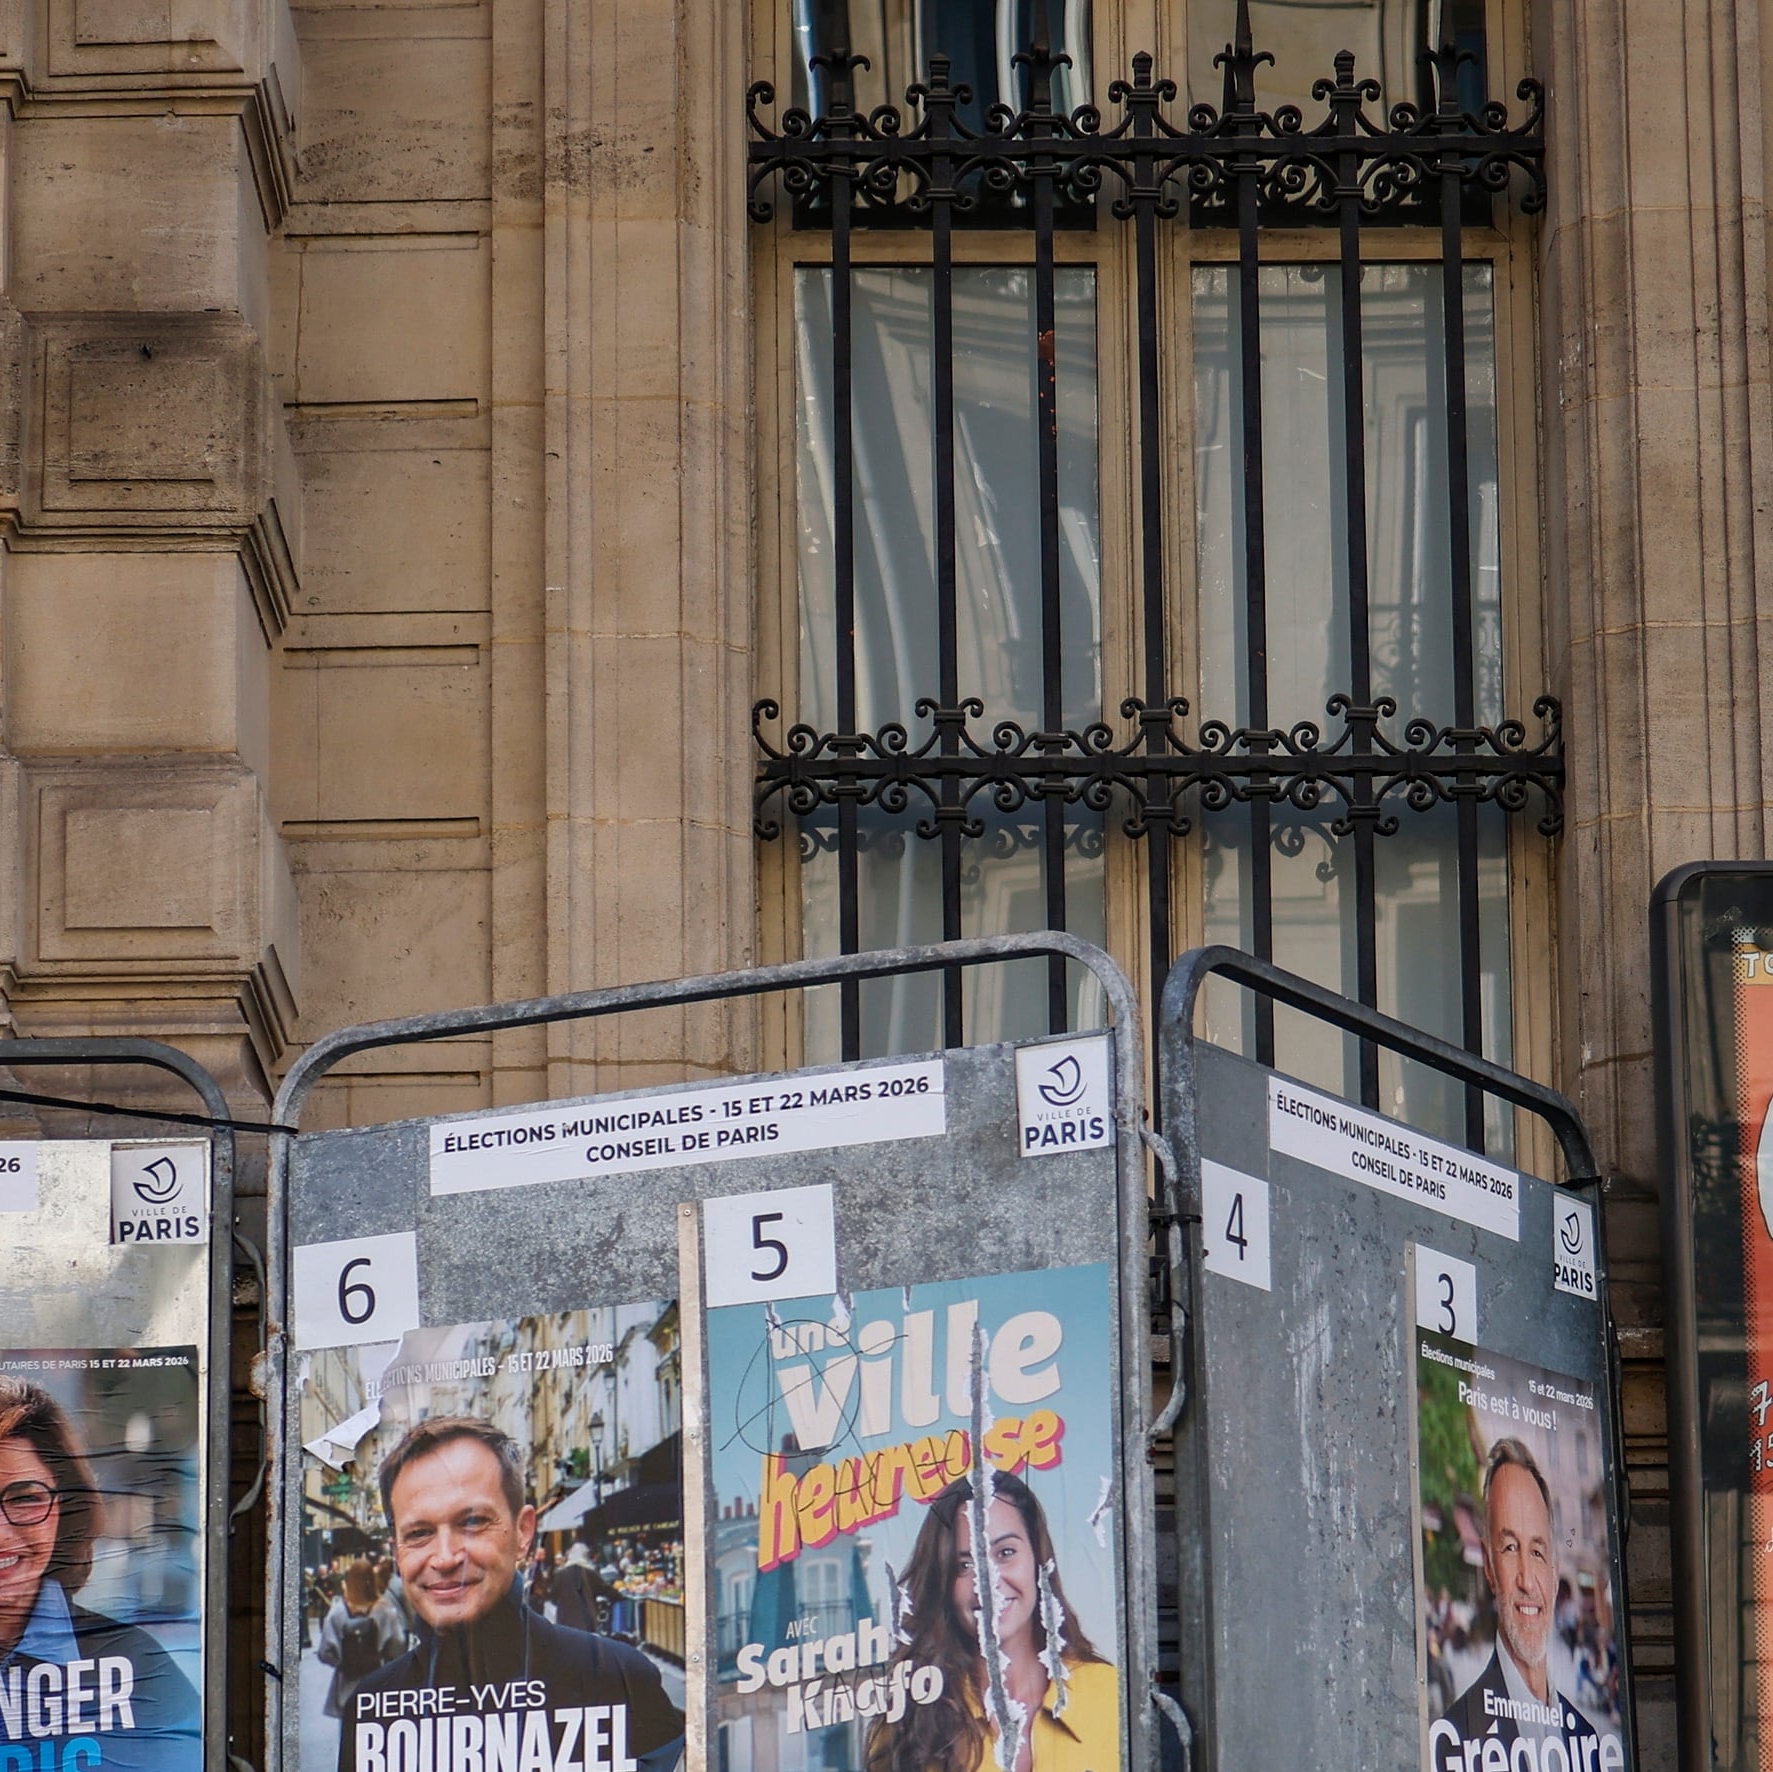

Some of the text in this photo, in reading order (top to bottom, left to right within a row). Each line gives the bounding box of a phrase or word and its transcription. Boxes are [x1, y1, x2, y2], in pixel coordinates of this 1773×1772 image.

[445, 1077, 928, 1152] ÉLECTIONS MUNICIPALES 15 ET 22 MARS 2026
[1026, 1117, 1104, 1148] PARIS
[1037, 1107, 1091, 1121] VILLE DE
[587, 1124, 778, 1162] CONSEIL DE PARIS
[1278, 1094, 1512, 1199] ÉLECTIONS MUNICIPALES 15 ET 22 MARS 2026
[1352, 1151, 1445, 1199] CONSEIL DE PARIS
[120, 1217, 199, 1242] PARIS
[132, 1206, 186, 1216] VILLE DE
[1226, 1194, 1247, 1260] 4
[752, 1213, 788, 1281] 5
[339, 1258, 375, 1324] 6
[1554, 1262, 1593, 1293] PARIS
[1436, 1274, 1455, 1339] 3
[1459, 1381, 1556, 1430] Paris est à vous!
[786, 1616, 818, 1640] AVEC
[736, 1617, 890, 1694] Sarah
[357, 1681, 545, 1718] PIERRE-YVES
[787, 1659, 944, 1735] Knafo
[1484, 1689, 1563, 1727] Emmanuel
